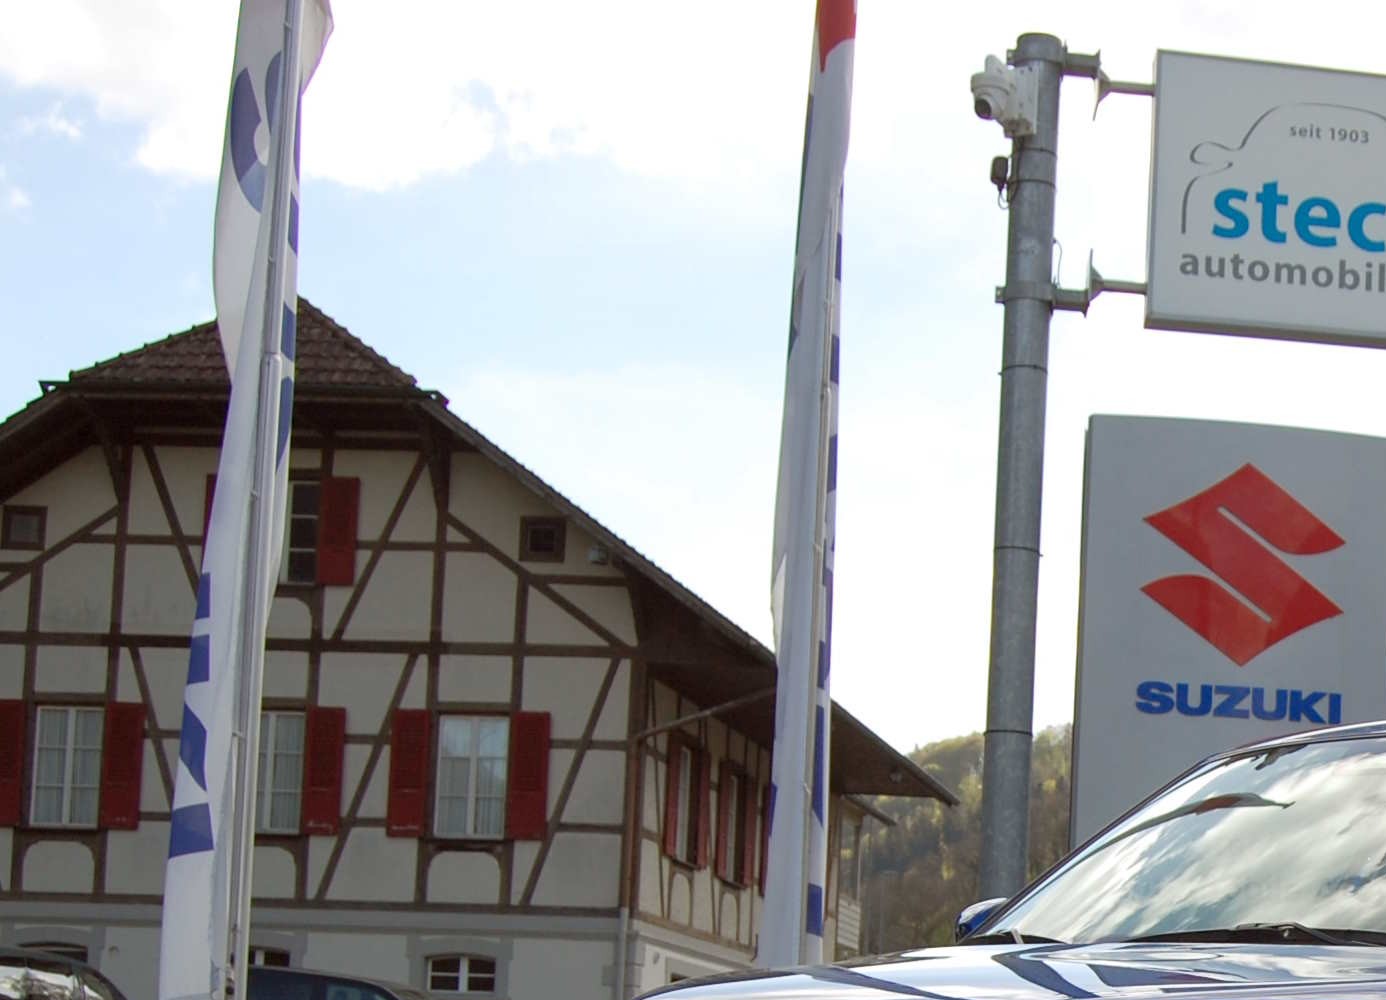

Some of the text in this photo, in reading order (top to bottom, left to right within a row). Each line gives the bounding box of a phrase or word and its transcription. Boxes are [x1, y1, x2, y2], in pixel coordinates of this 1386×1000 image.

[1289, 124, 1370, 144] seit 1903
[1135, 680, 1342, 725] SUZUKI
